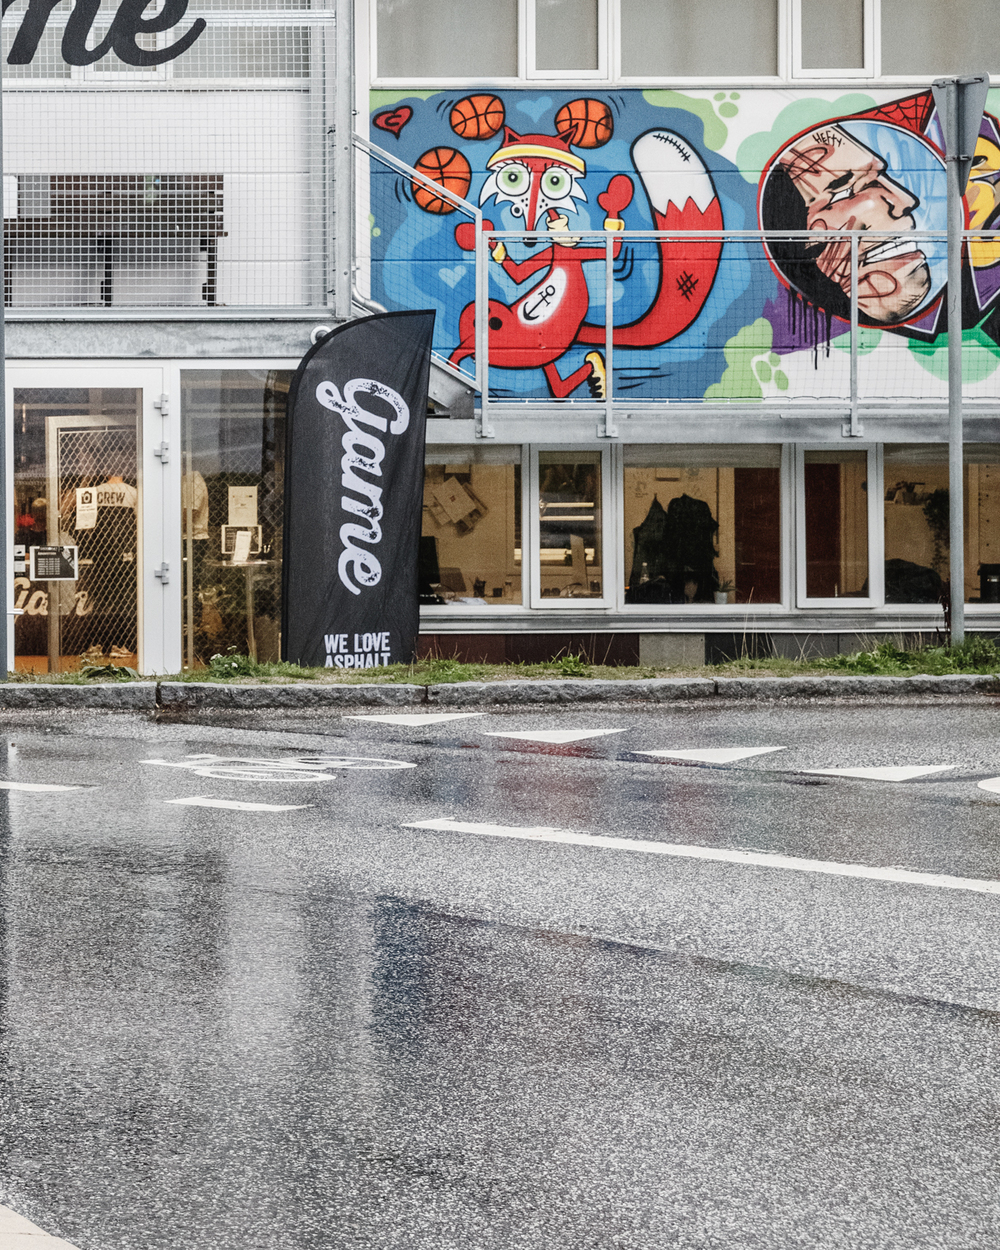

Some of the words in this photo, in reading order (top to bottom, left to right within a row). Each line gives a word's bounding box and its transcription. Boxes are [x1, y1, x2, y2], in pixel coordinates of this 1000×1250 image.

[316, 378, 410, 595] Game
[97, 491, 126, 505] CREW
[324, 634, 349, 654] WE
[354, 632, 391, 652] LOVE
[324, 653, 391, 669] ASPHALT
